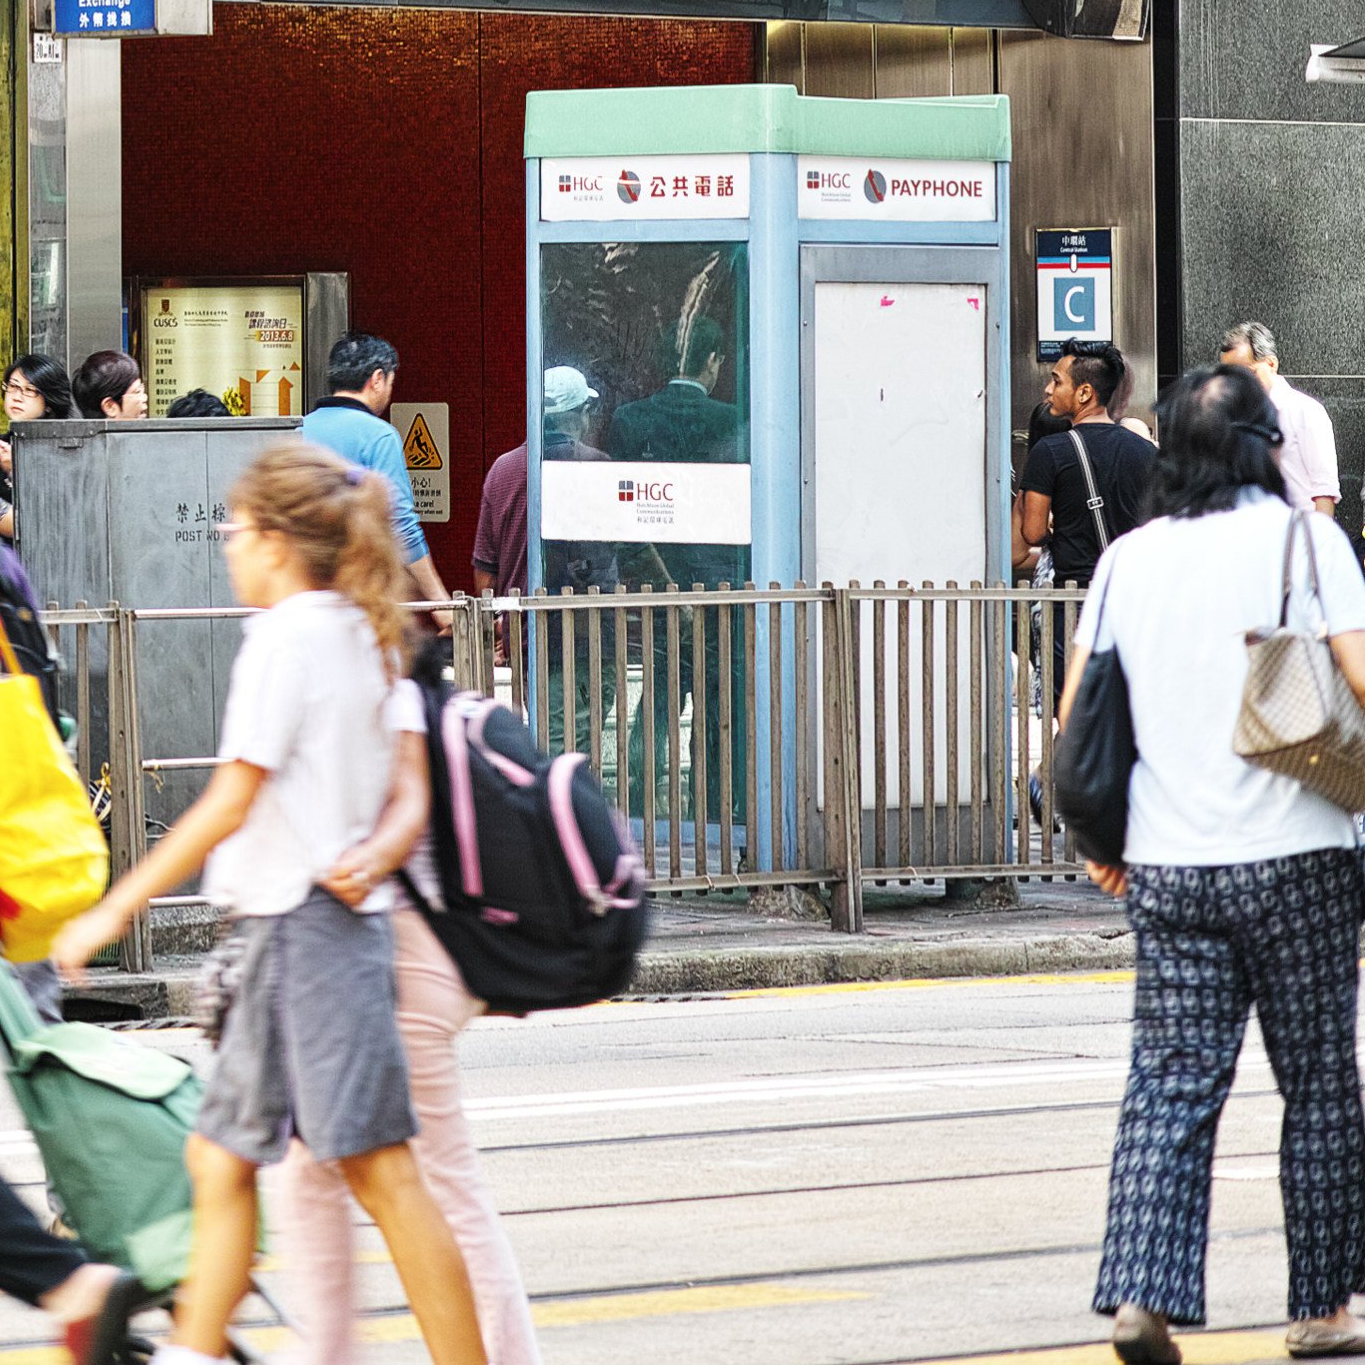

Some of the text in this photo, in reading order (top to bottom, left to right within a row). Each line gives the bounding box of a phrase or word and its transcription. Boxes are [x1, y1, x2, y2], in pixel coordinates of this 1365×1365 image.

[650, 175, 734, 197] 公共電話
[821, 173, 851, 189] HGC
[891, 179, 983, 198] PAYPHONE
[1064, 285, 1086, 323] C
[154, 317, 178, 327] CUSCS
[260, 331, 294, 341] 2013.6.8
[636, 483, 674, 501] HGC
[175, 530, 202, 542] POST
[206, 531, 220, 541] NO
